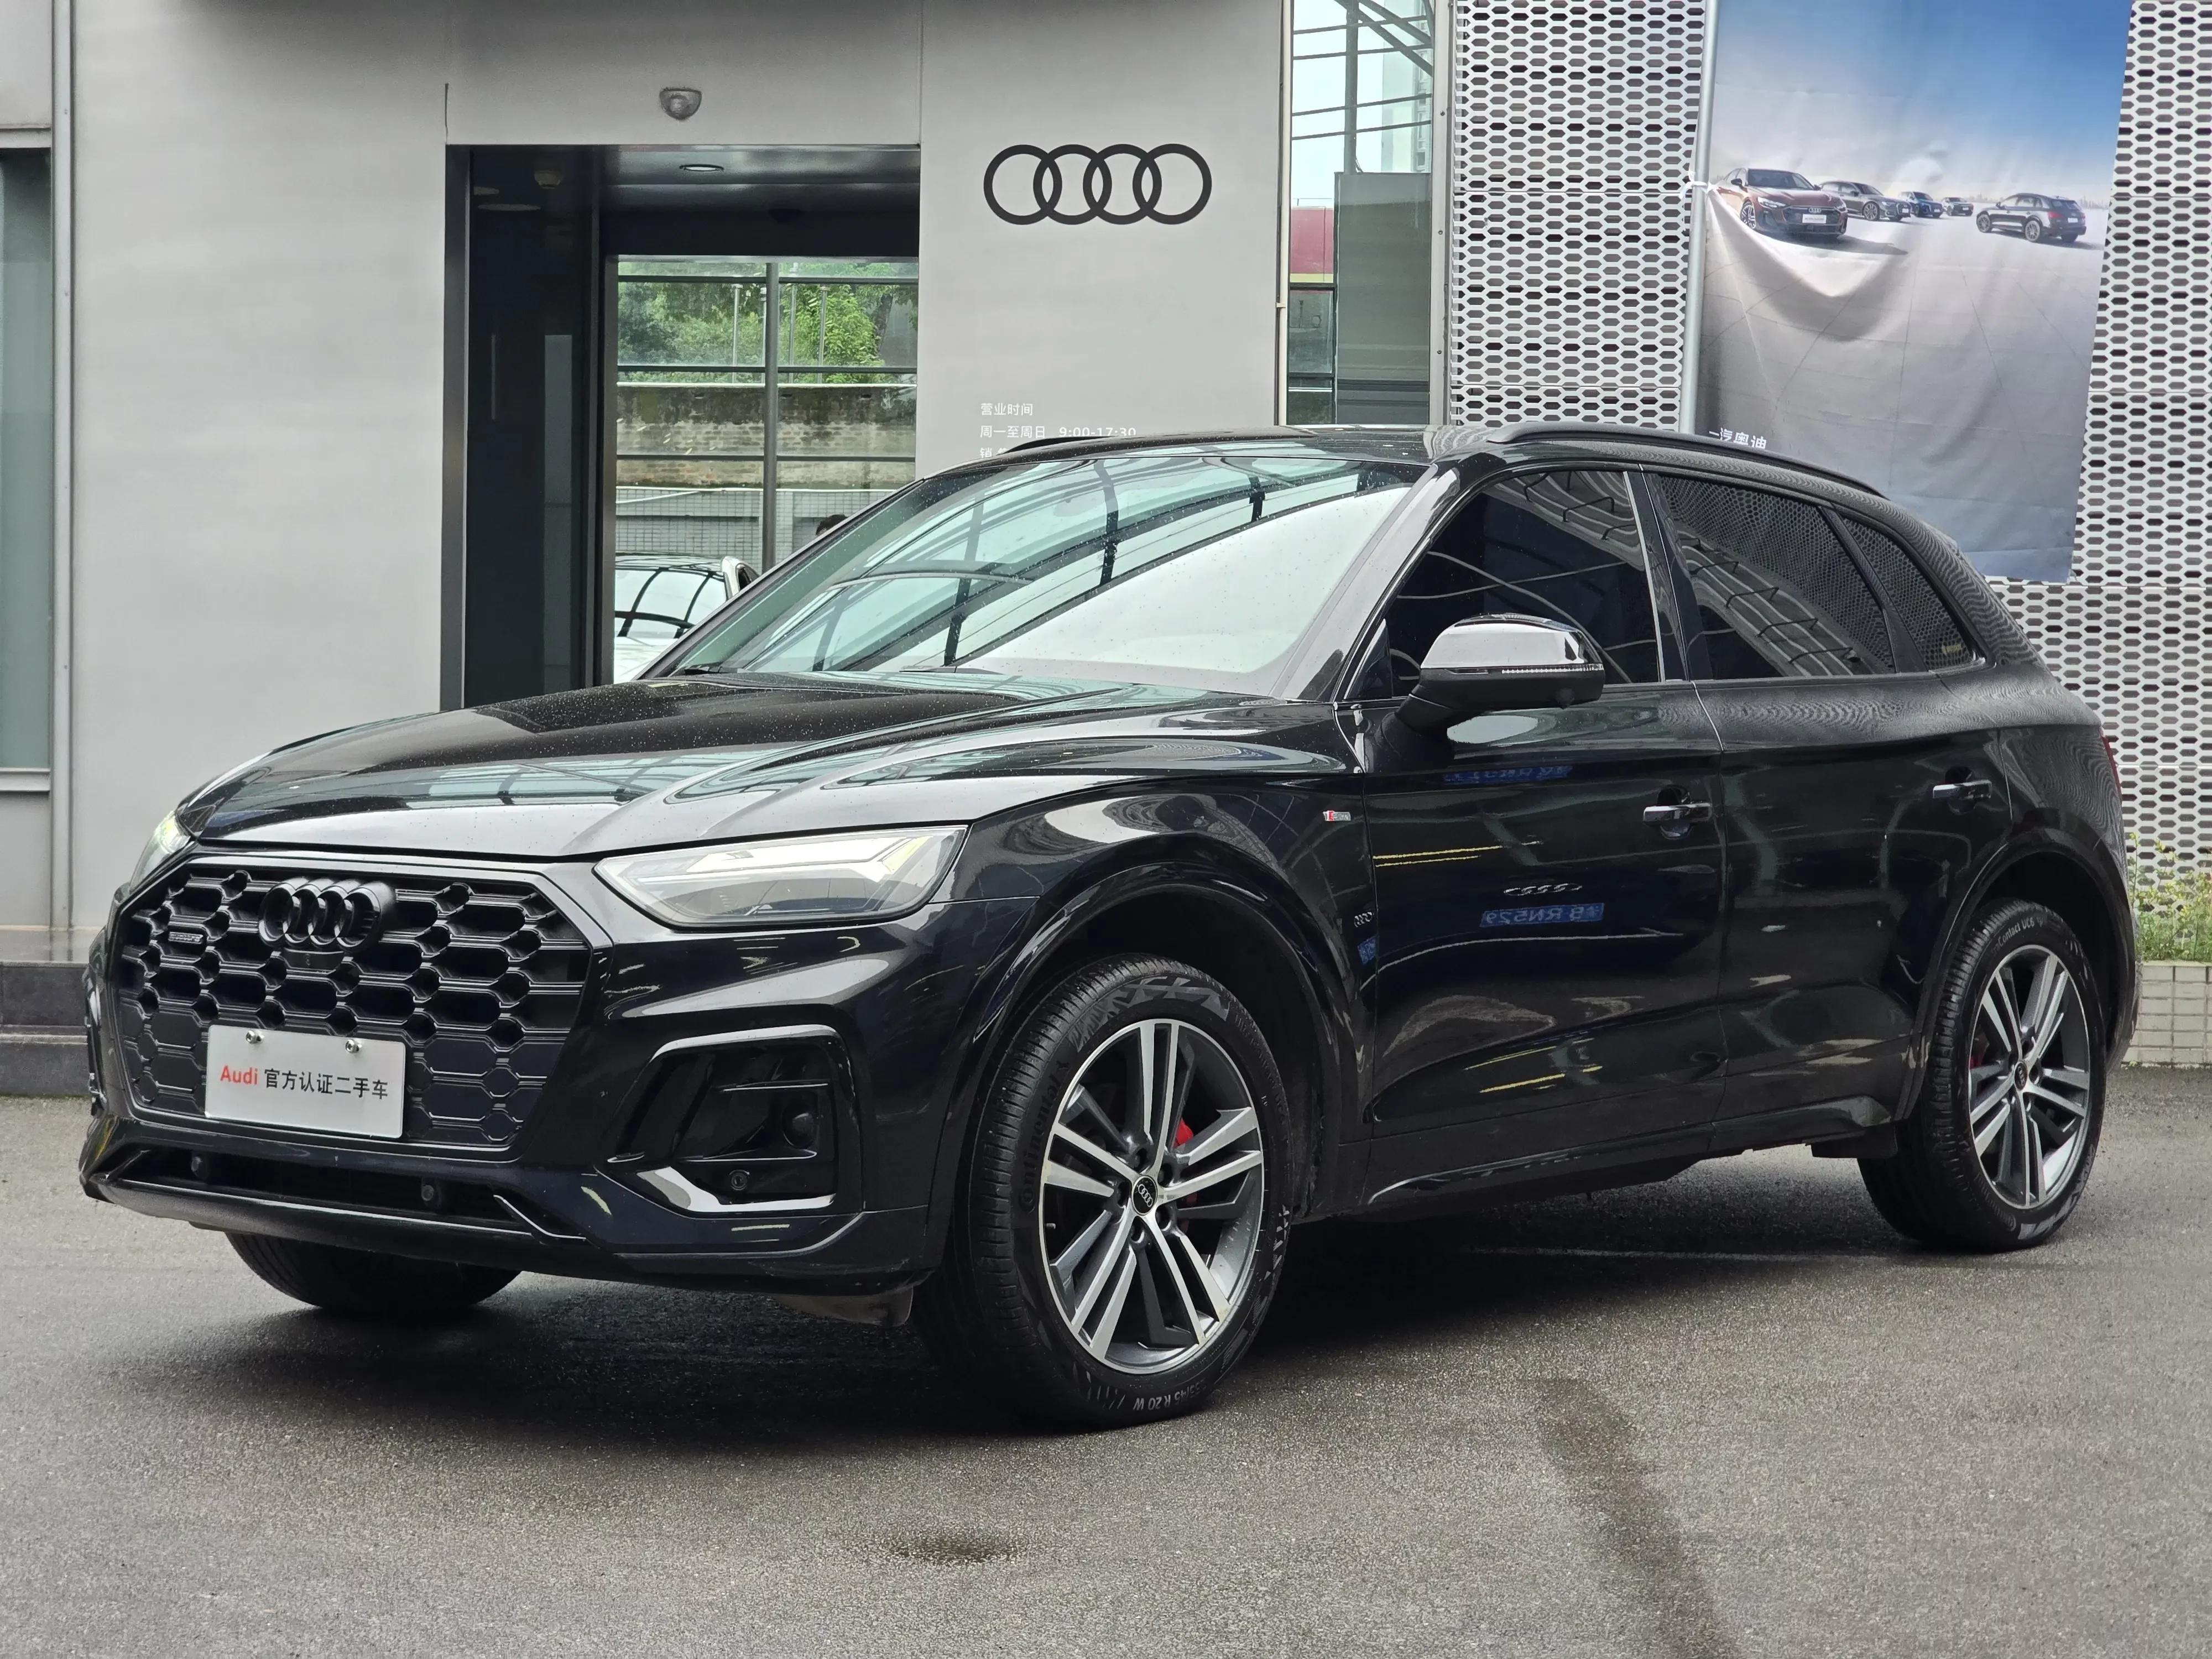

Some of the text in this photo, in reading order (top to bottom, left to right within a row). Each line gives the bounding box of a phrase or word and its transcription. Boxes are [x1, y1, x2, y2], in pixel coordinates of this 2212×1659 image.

[980, 403, 1033, 416] 营业时间
[980, 425, 1136, 439] 周一至周日 9:00-17:30
[1709, 427, 1767, 450] 一汽奥迪
[1990, 922, 2021, 957] raContact
[220, 1065, 388, 1100] Audi 官方认证二手车
